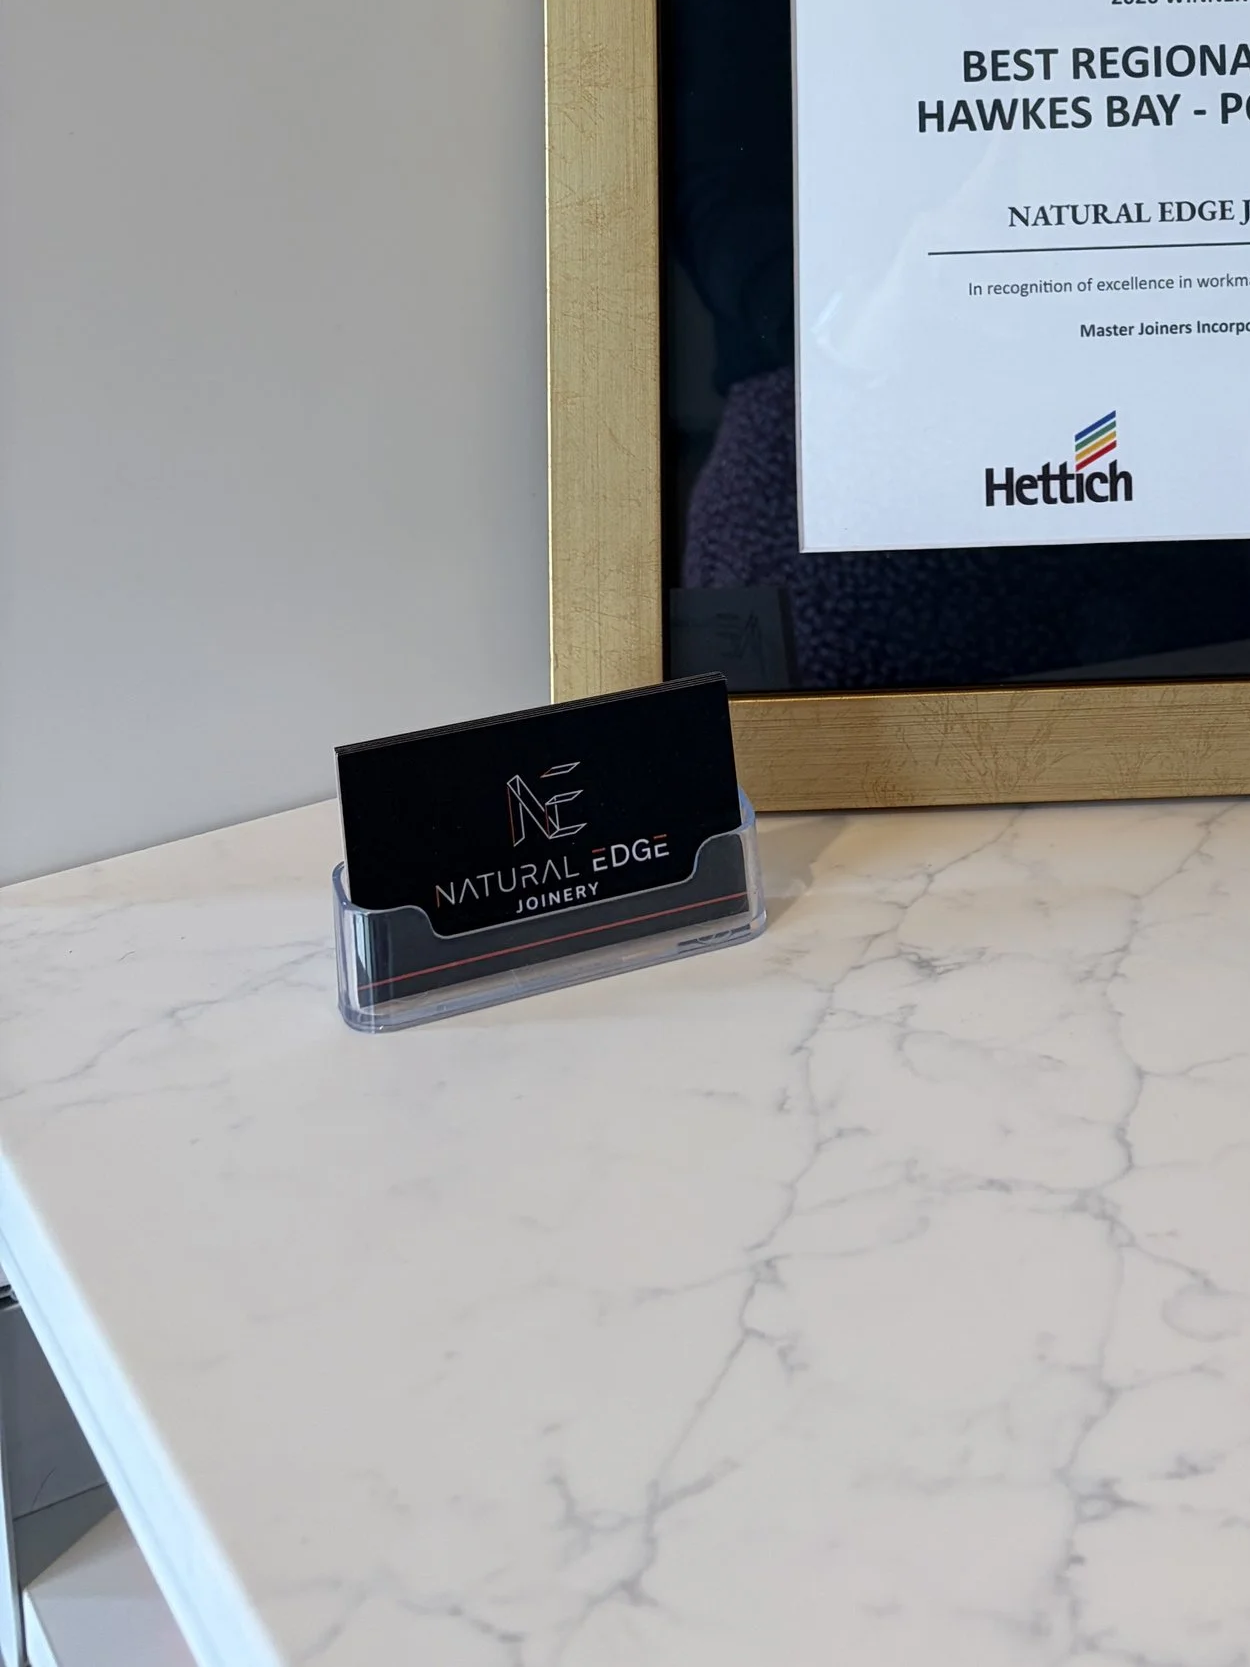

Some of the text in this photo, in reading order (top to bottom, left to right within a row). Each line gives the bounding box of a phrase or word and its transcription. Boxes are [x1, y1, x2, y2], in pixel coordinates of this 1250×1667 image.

[962, 48, 1059, 83] BEST
[918, 95, 1093, 134] HAWKES
[1106, 93, 1182, 128] BAY
[1007, 201, 1152, 228] NATURAL
[1158, 199, 1236, 224] EDGE
[968, 282, 983, 296] In
[987, 280, 1072, 296] recognition
[1077, 278, 1092, 292] of
[1096, 275, 1175, 291] excellence
[1179, 274, 1193, 289] in
[1080, 323, 1134, 337] Master
[1138, 321, 1192, 335] Joiners
[985, 459, 1133, 507] Hettich
[435, 834, 670, 908] NATURAL EDGE
[516, 881, 600, 914] JOINERY
